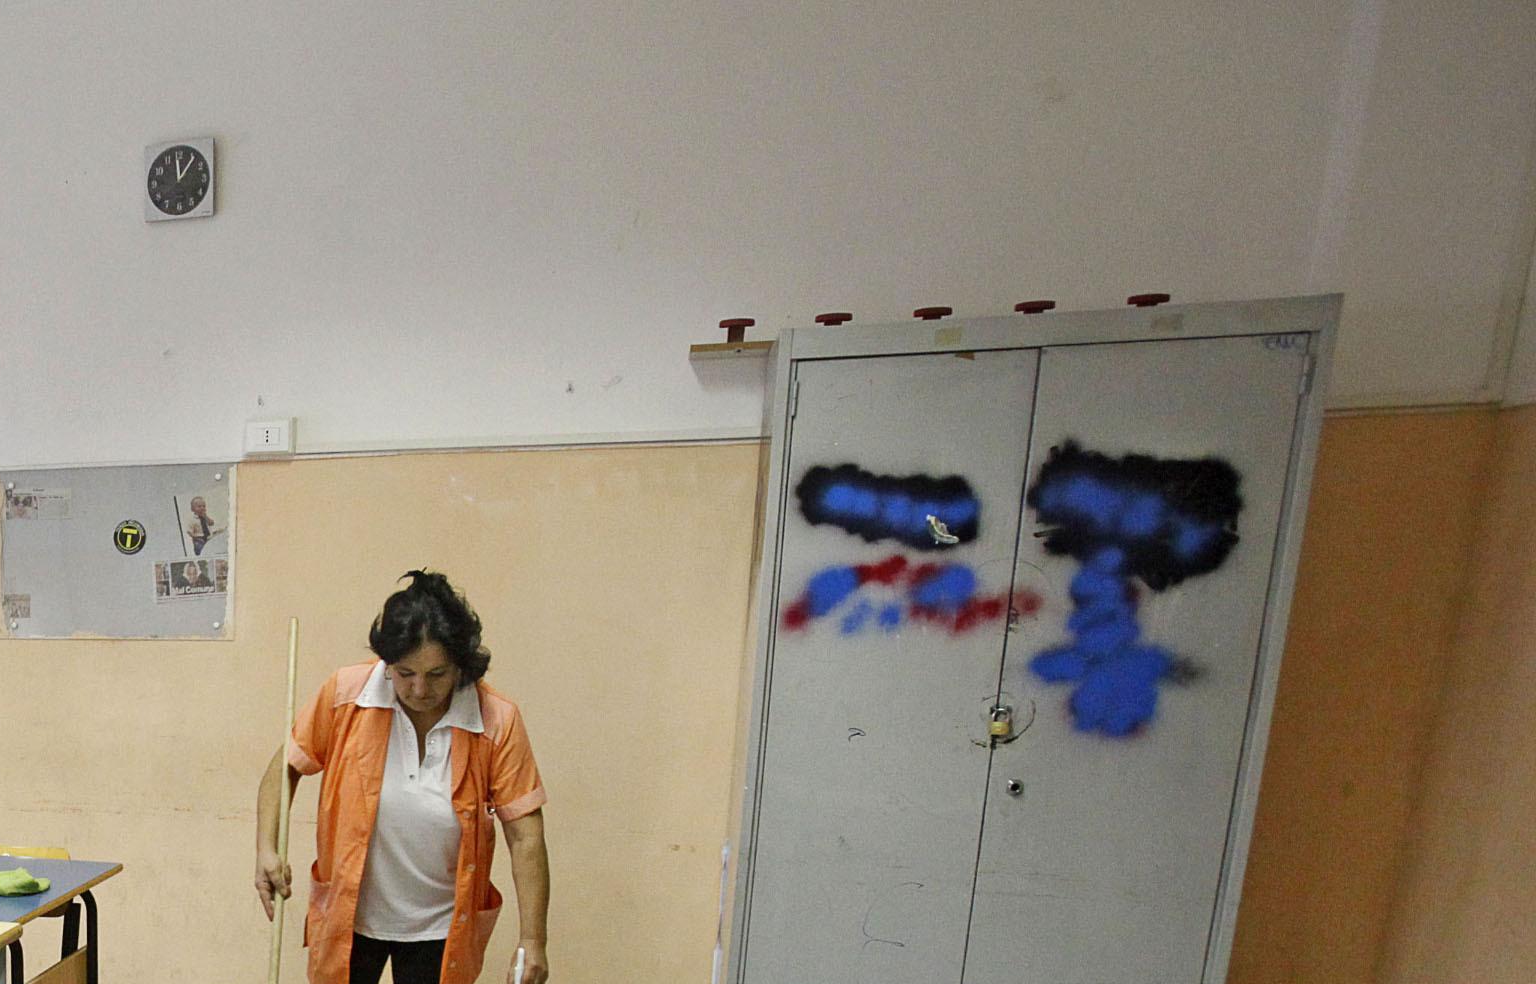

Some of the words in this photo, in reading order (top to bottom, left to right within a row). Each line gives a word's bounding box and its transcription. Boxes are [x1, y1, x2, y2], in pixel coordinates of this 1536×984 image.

[165, 154, 171, 165] 11
[155, 167, 164, 176] 10
[122, 527, 138, 548] T
